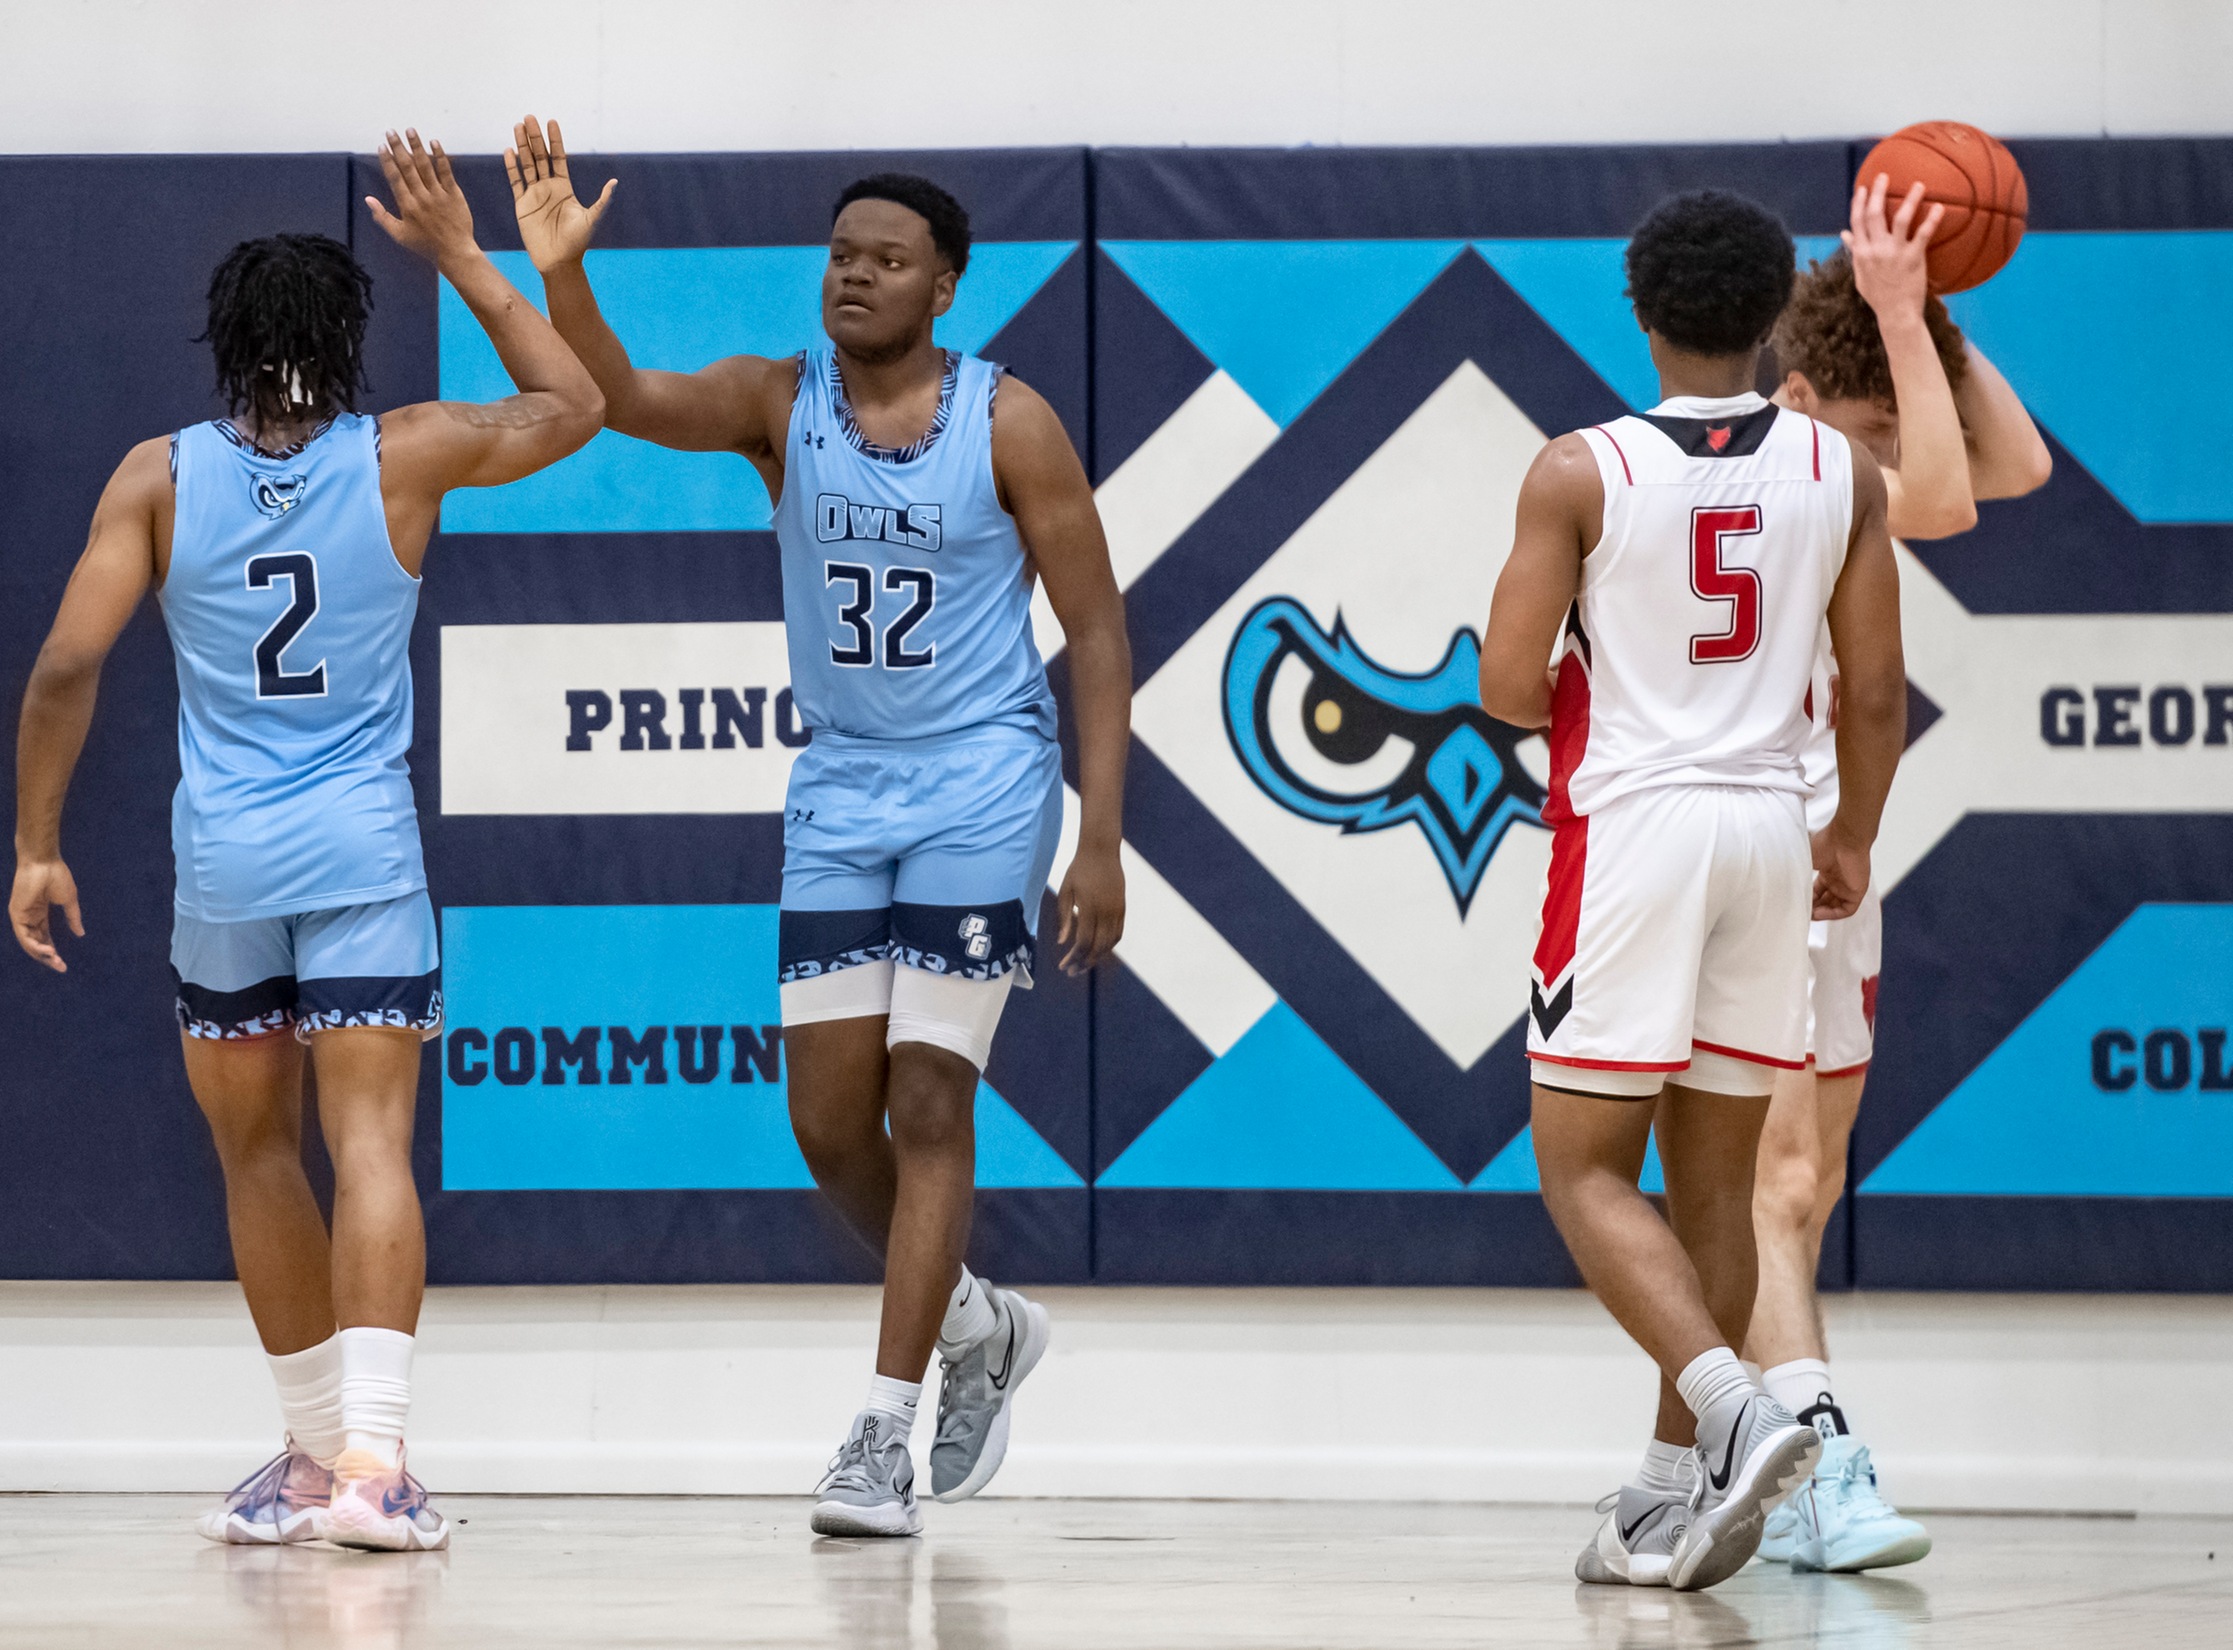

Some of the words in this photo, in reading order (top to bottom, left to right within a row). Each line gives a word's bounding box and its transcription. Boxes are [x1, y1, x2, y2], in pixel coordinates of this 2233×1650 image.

[816, 493, 942, 552] OWLS
[1690, 504, 1763, 664] 5
[244, 550, 328, 700] 2
[823, 560, 936, 671] 32
